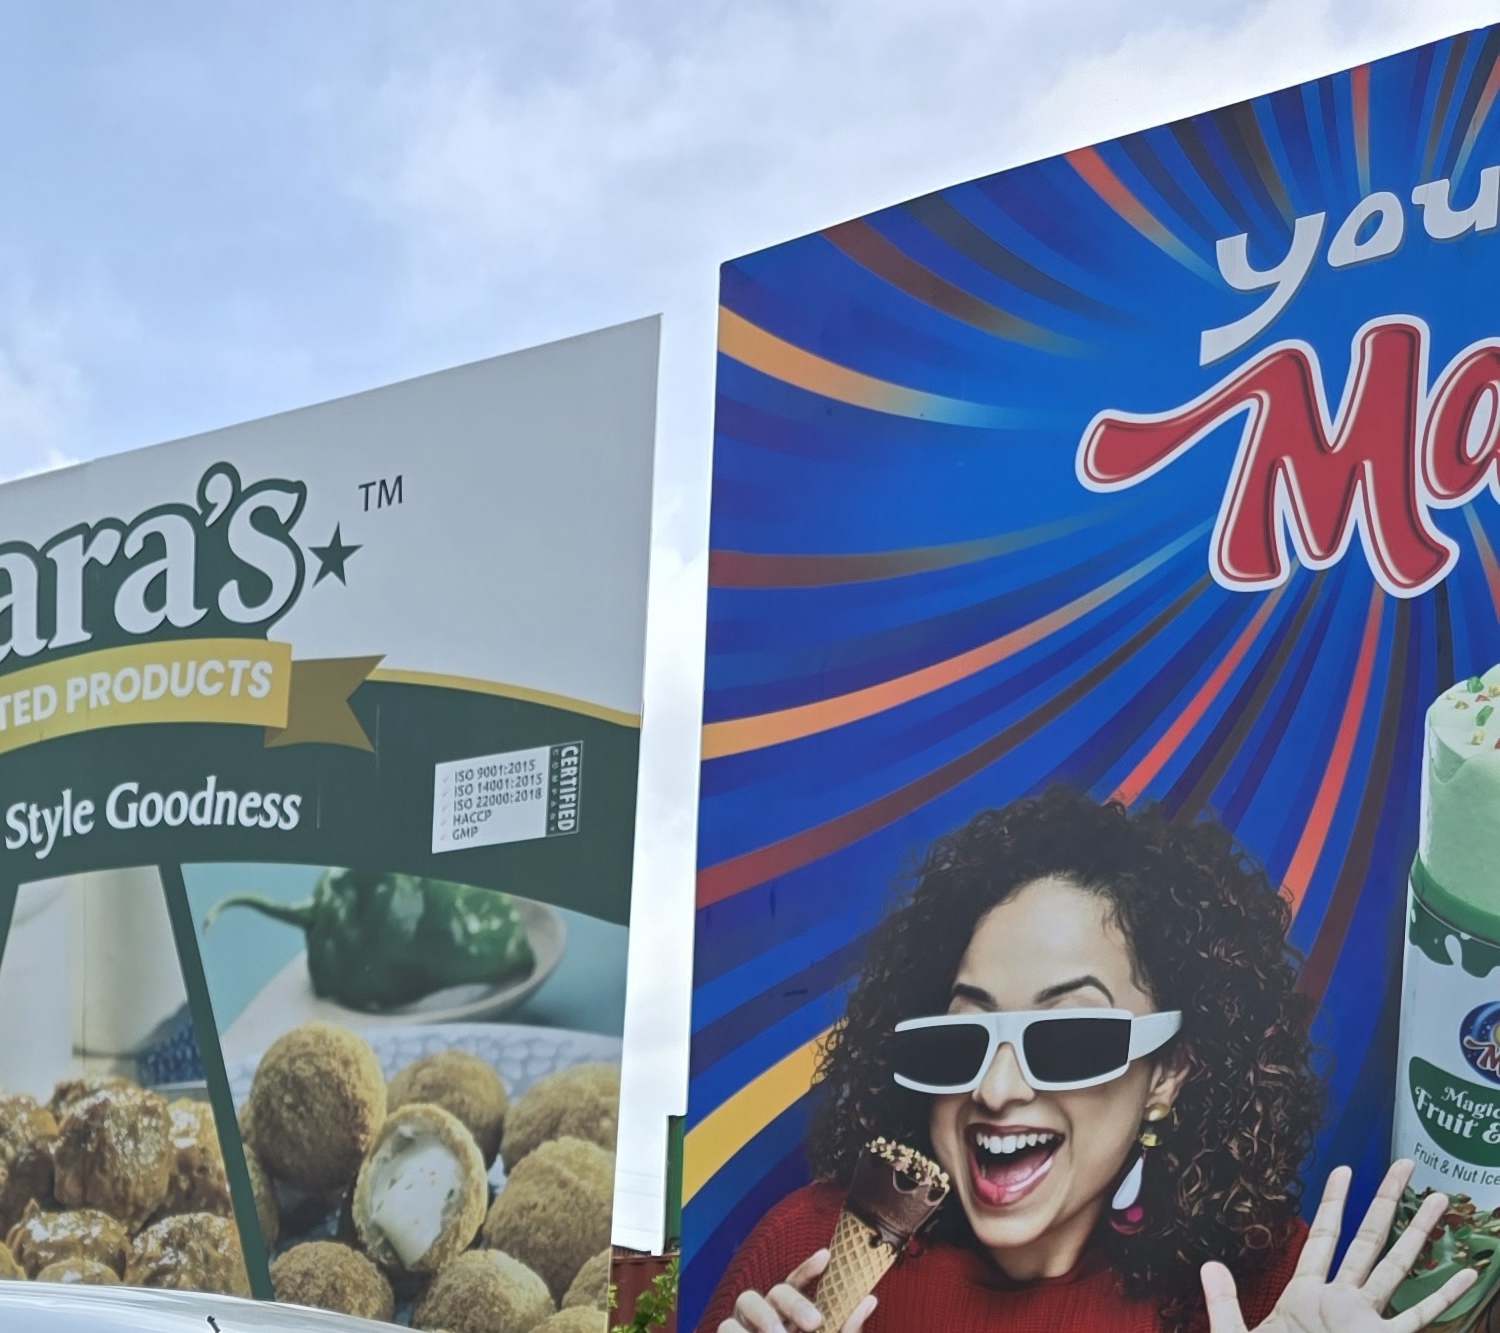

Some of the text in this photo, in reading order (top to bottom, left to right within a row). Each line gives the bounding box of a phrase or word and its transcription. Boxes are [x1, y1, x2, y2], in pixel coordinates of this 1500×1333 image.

[357, 474, 404, 513] TM
[65, 659, 274, 716] PRODUCTS
[454, 759, 536, 783] ISO 9001:2015
[454, 772, 543, 798] ISO 14001:2015
[557, 745, 580, 832] CERTIFIED
[4, 788, 96, 861] Style
[104, 774, 302, 831] Goodness
[453, 787, 543, 812] ISO 22000:2018
[453, 809, 492, 827] HACCP
[452, 825, 479, 841] GMP
[1414, 1086, 1479, 1139] Fruit
[1413, 1142, 1439, 1174] Fruit
[1440, 1159, 1450, 1175] &
[1452, 1163, 1478, 1183] Nut
